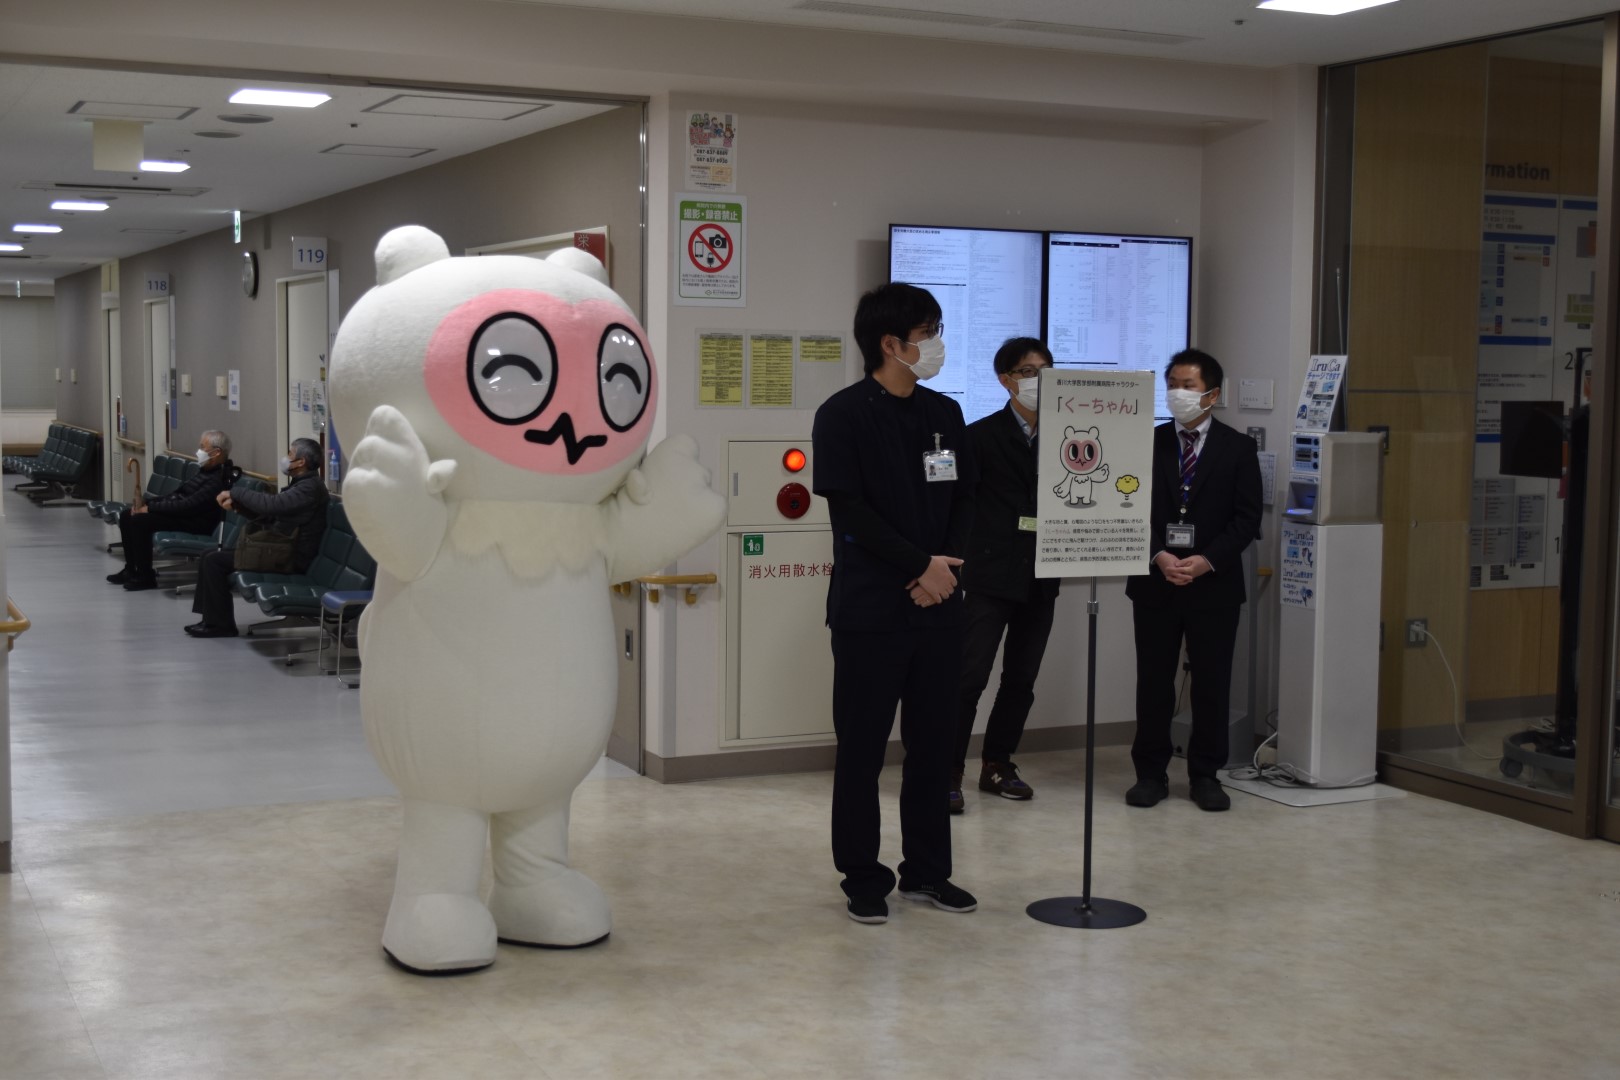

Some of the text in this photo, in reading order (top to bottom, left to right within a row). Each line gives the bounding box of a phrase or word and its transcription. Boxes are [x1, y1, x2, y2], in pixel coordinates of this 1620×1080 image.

[683, 208, 738, 220] 撮影・録音禁止
[297, 249, 324, 263] 119
[147, 280, 167, 291] 118
[1310, 359, 1341, 372] IruCa
[1565, 352, 1574, 370] 2
[1056, 379, 1140, 388] 香川大学医学部附属病院キャラクター
[1057, 396, 1139, 415] 「くーちゃん」
[748, 562, 833, 579] 消火用散水栓
